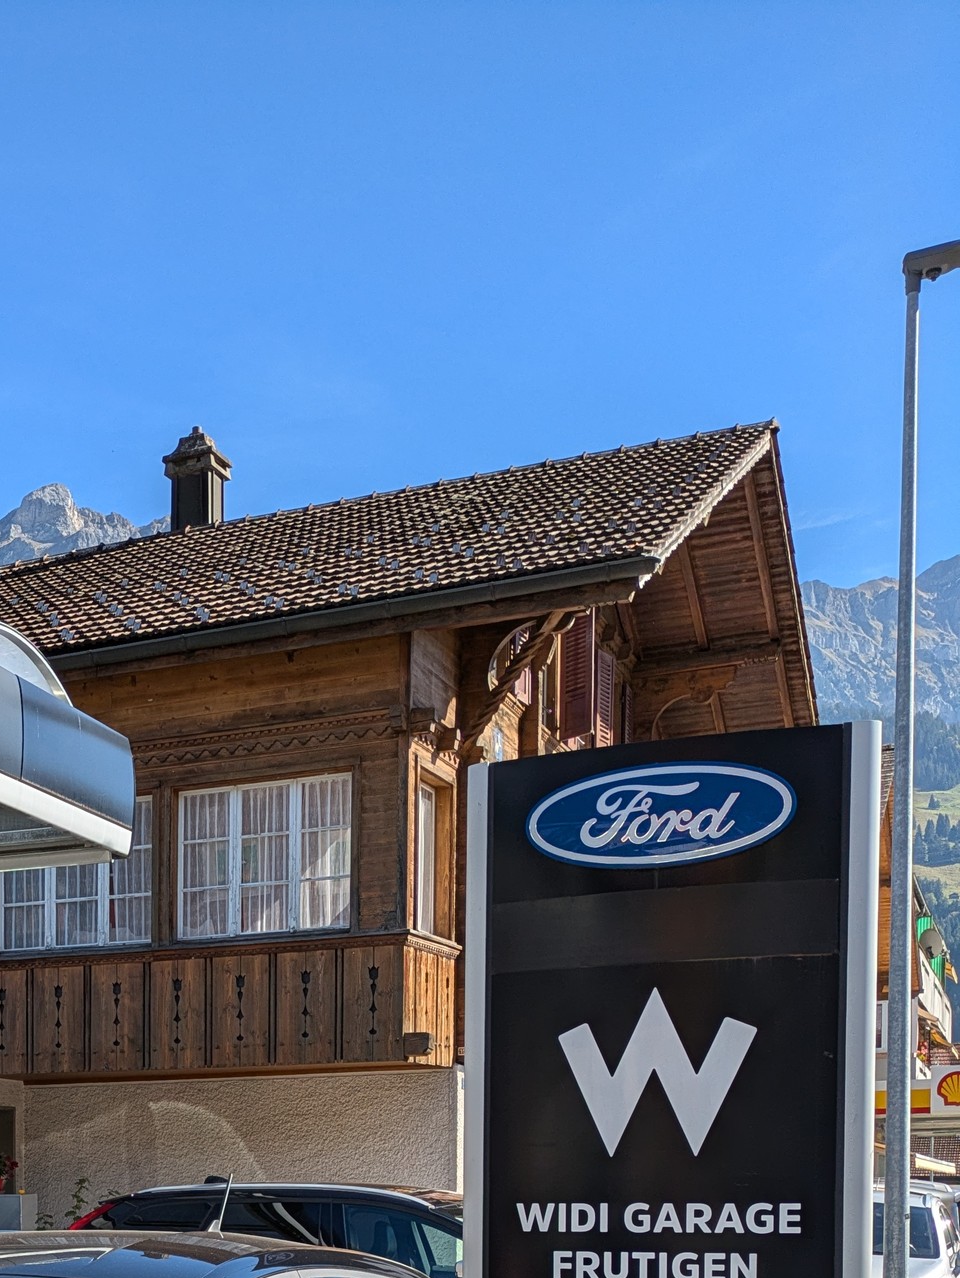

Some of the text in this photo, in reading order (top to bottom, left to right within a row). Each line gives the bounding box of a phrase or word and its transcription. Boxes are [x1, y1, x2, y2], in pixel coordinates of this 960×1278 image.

[579, 781, 741, 849] Ford
[558, 987, 758, 1157] W
[516, 1202, 802, 1234] WIDI GARAGE
